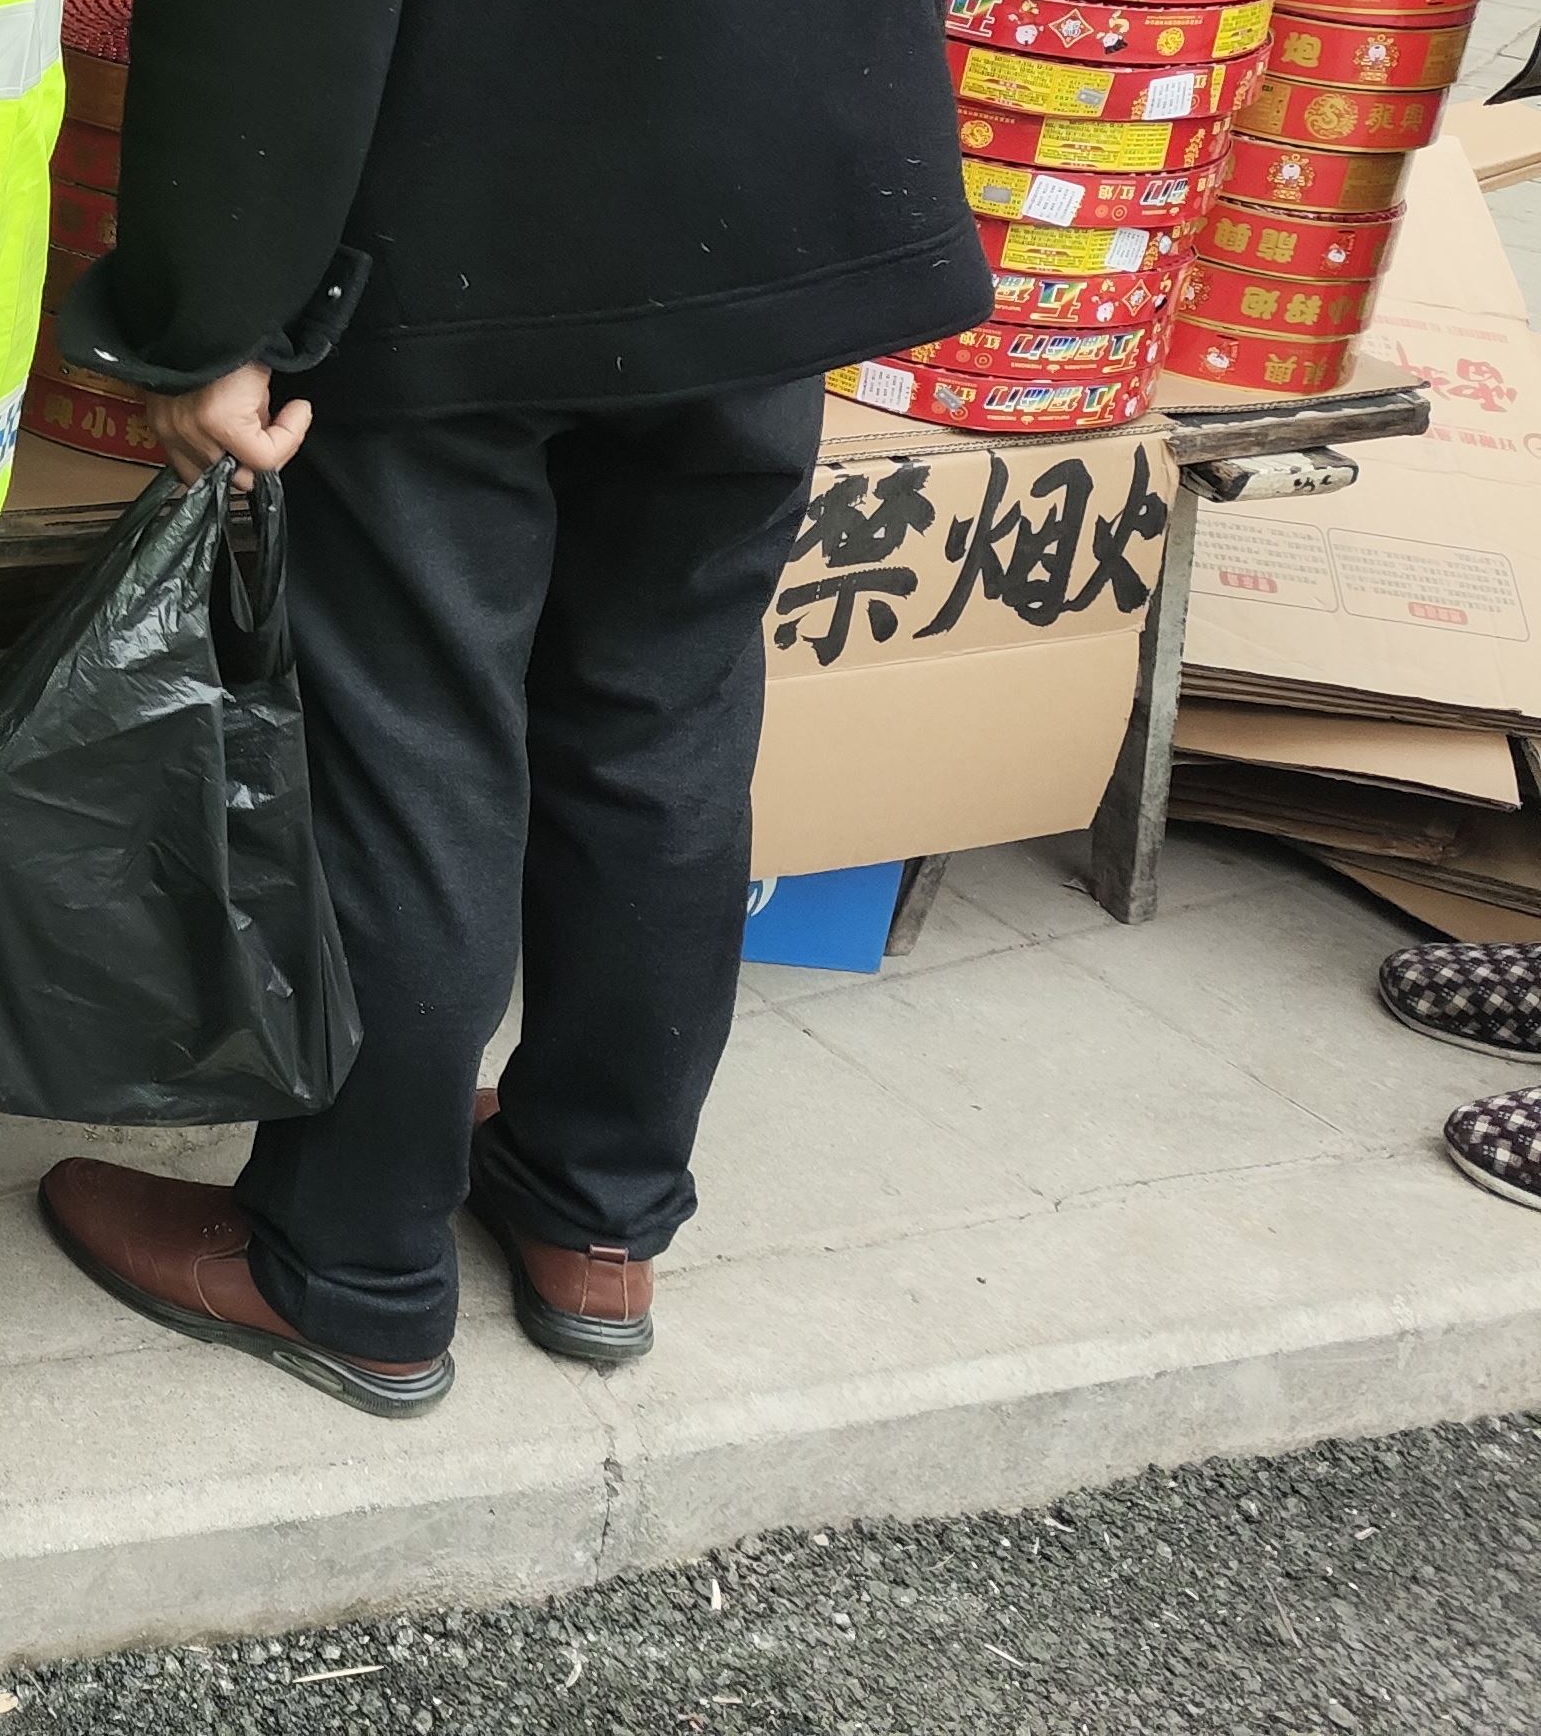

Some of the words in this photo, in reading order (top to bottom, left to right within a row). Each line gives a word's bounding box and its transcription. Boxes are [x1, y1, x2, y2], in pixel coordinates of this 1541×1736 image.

[1006, 328, 1146, 374] 五福临门
[982, 382, 1122, 426] 五福临门
